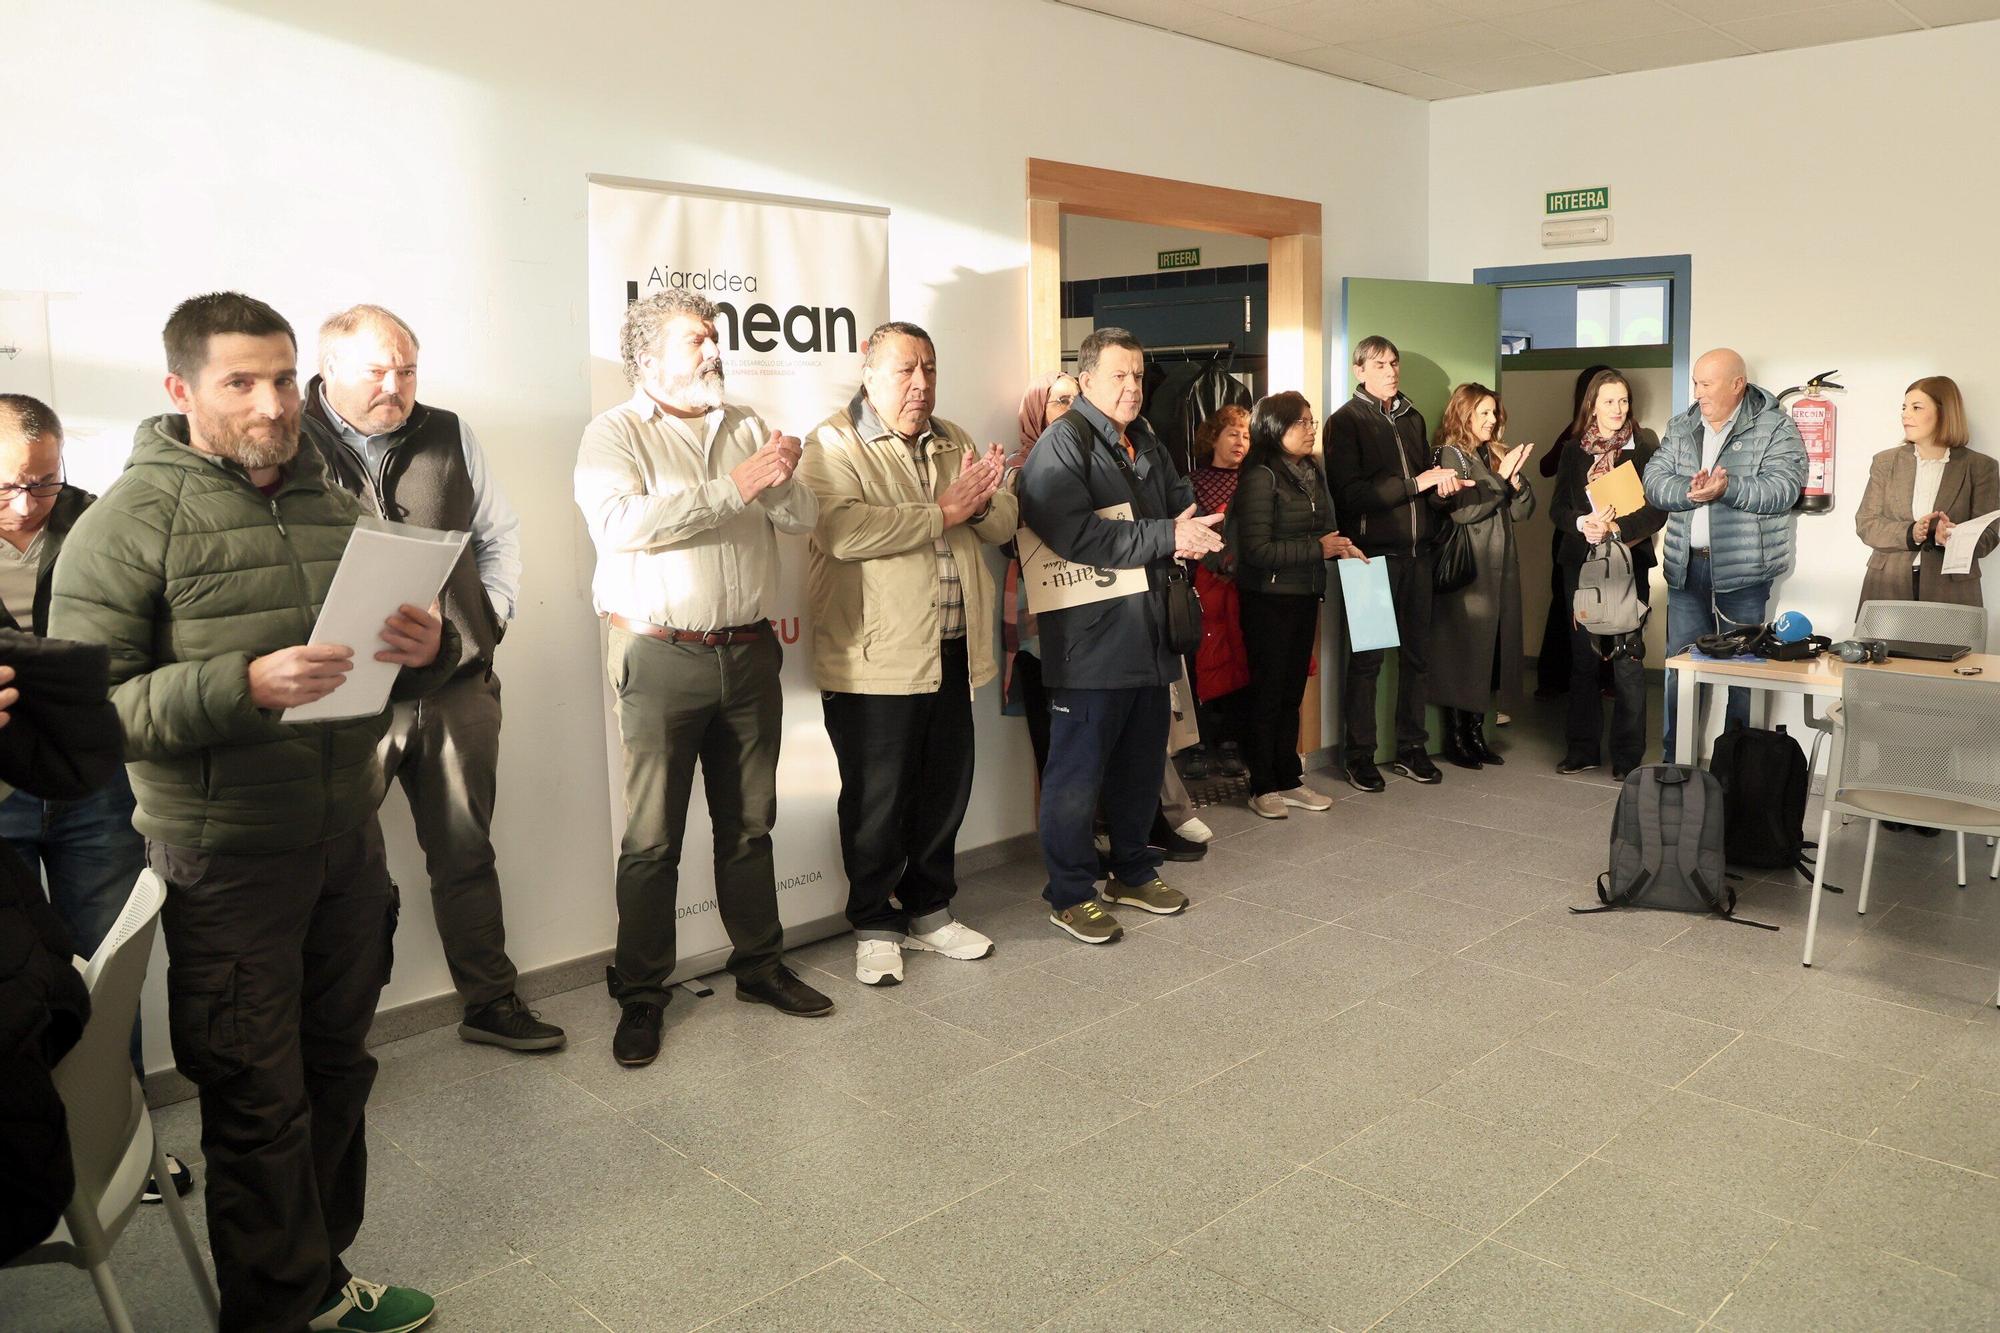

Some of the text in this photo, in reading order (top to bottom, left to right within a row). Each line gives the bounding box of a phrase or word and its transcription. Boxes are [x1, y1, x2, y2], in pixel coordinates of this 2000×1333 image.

[1550, 190, 1605, 211] IRTEERA
[1160, 250, 1198, 267] IRTEERA
[647, 265, 758, 293] Aiaraldea
[675, 899, 718, 920] DACIÓN
